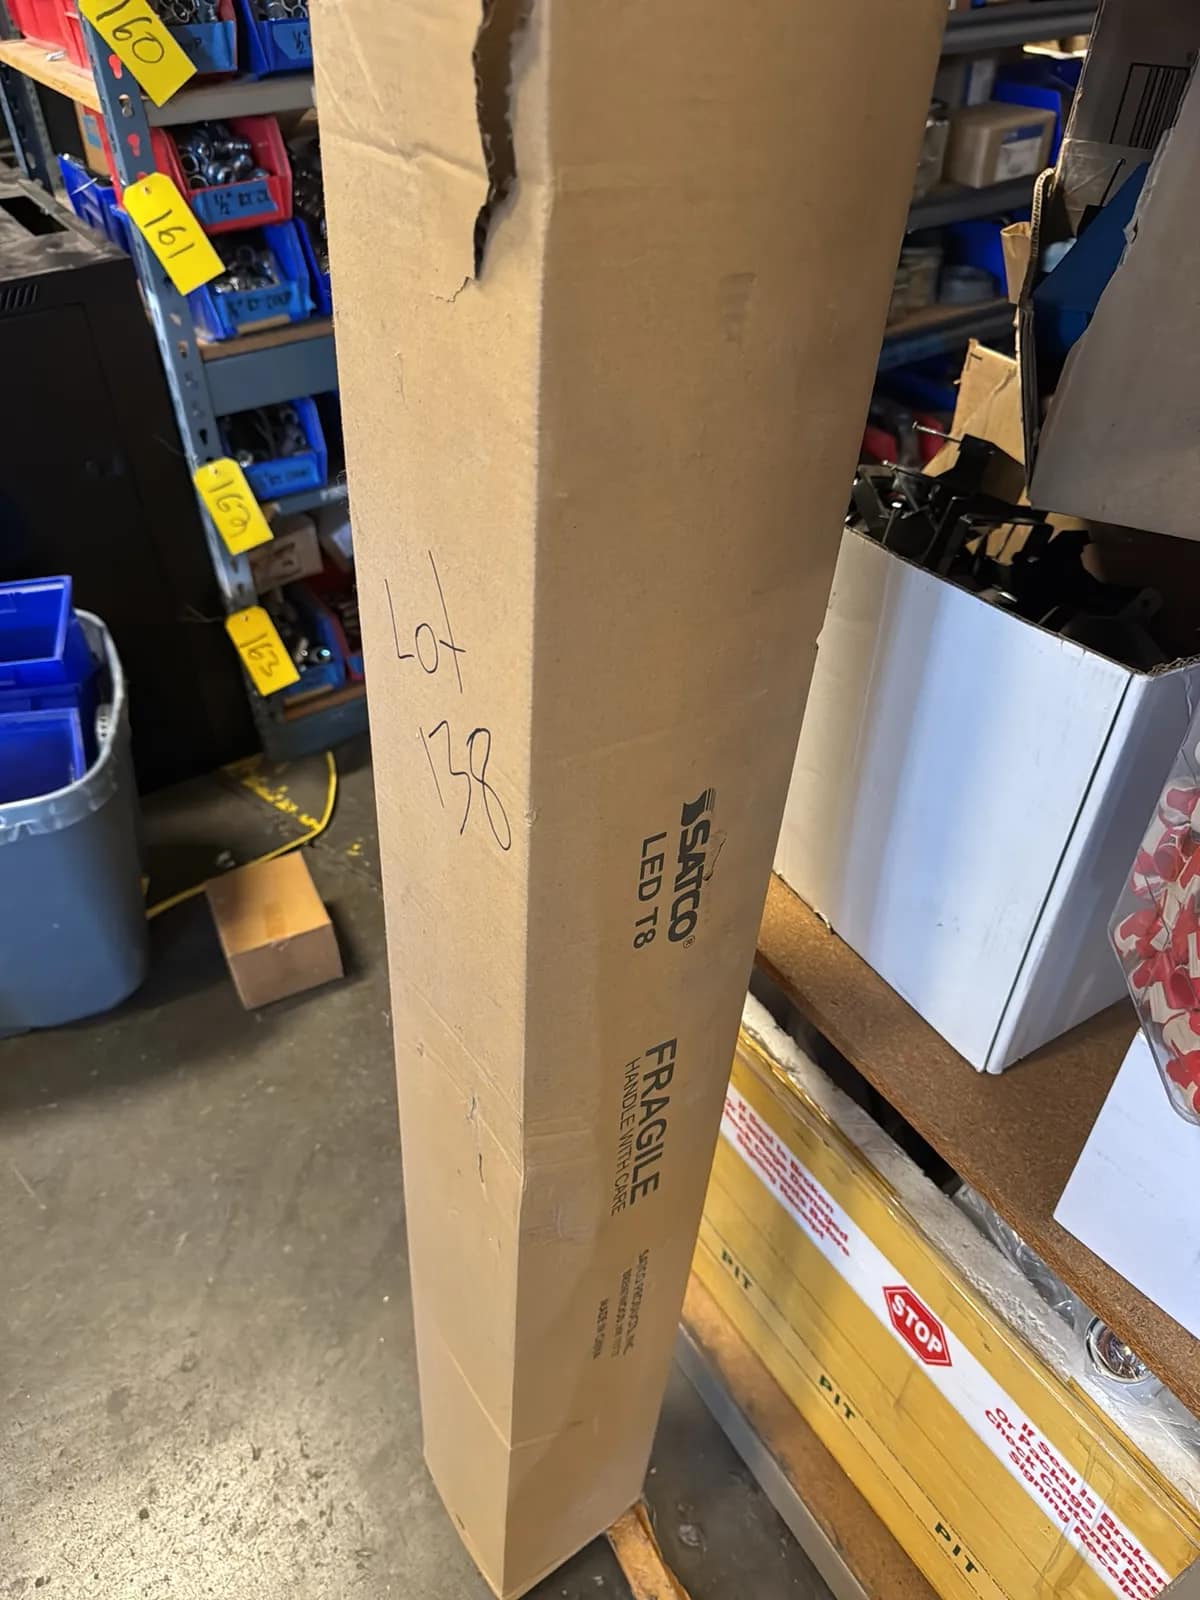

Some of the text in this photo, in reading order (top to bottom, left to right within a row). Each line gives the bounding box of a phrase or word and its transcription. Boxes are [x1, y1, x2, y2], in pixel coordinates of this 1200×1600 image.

[96, 0, 165, 63] 160
[144, 209, 195, 259] 161
[208, 479, 251, 538] 162
[239, 631, 280, 678] 163
[419, 719, 511, 851] 138
[633, 831, 667, 949] LED T8
[610, 1056, 641, 1217] HANDLE WITH CARE
[629, 1037, 678, 1206] FRAGILE
[890, 1294, 943, 1355] STOP
[819, 1374, 857, 1420] PIT
[984, 1409, 1036, 1471] Check
[1040, 1472, 1119, 1566] Contents
[995, 1407, 1017, 1431] Or
[1018, 1433, 1093, 1520] Package
[1022, 1422, 1036, 1438] If
[1038, 1440, 1077, 1486] Seal
[1080, 1488, 1097, 1509] Is
[934, 1522, 980, 1574] PIT
[1008, 1450, 1142, 1600] Signing Receip
